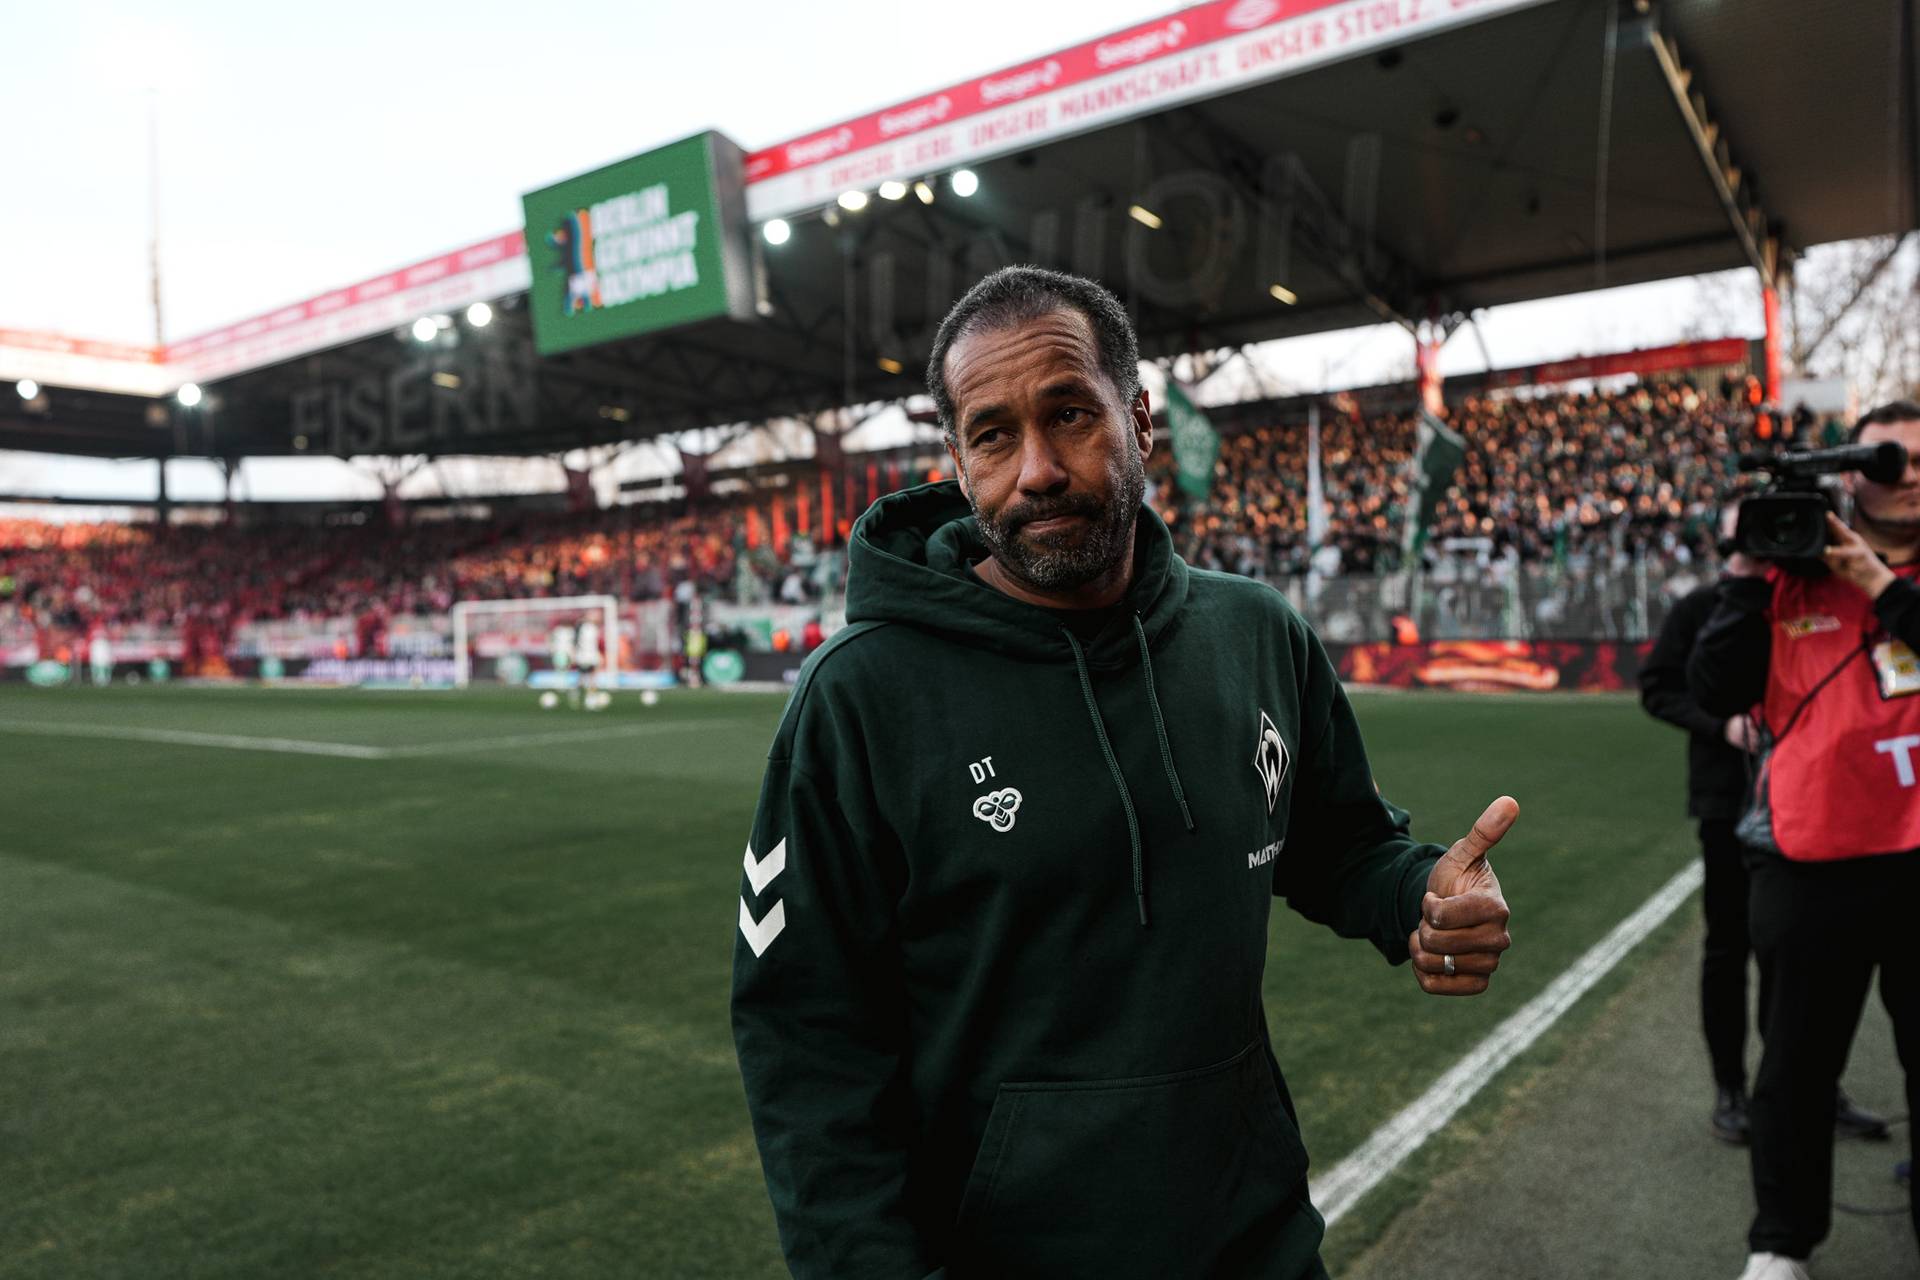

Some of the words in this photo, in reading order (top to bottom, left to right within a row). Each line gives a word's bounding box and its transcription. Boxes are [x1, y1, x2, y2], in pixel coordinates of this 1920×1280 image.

[1235, 24, 1326, 71] UNSER
[591, 183, 669, 238] BERLIN
[968, 756, 997, 785] DT
